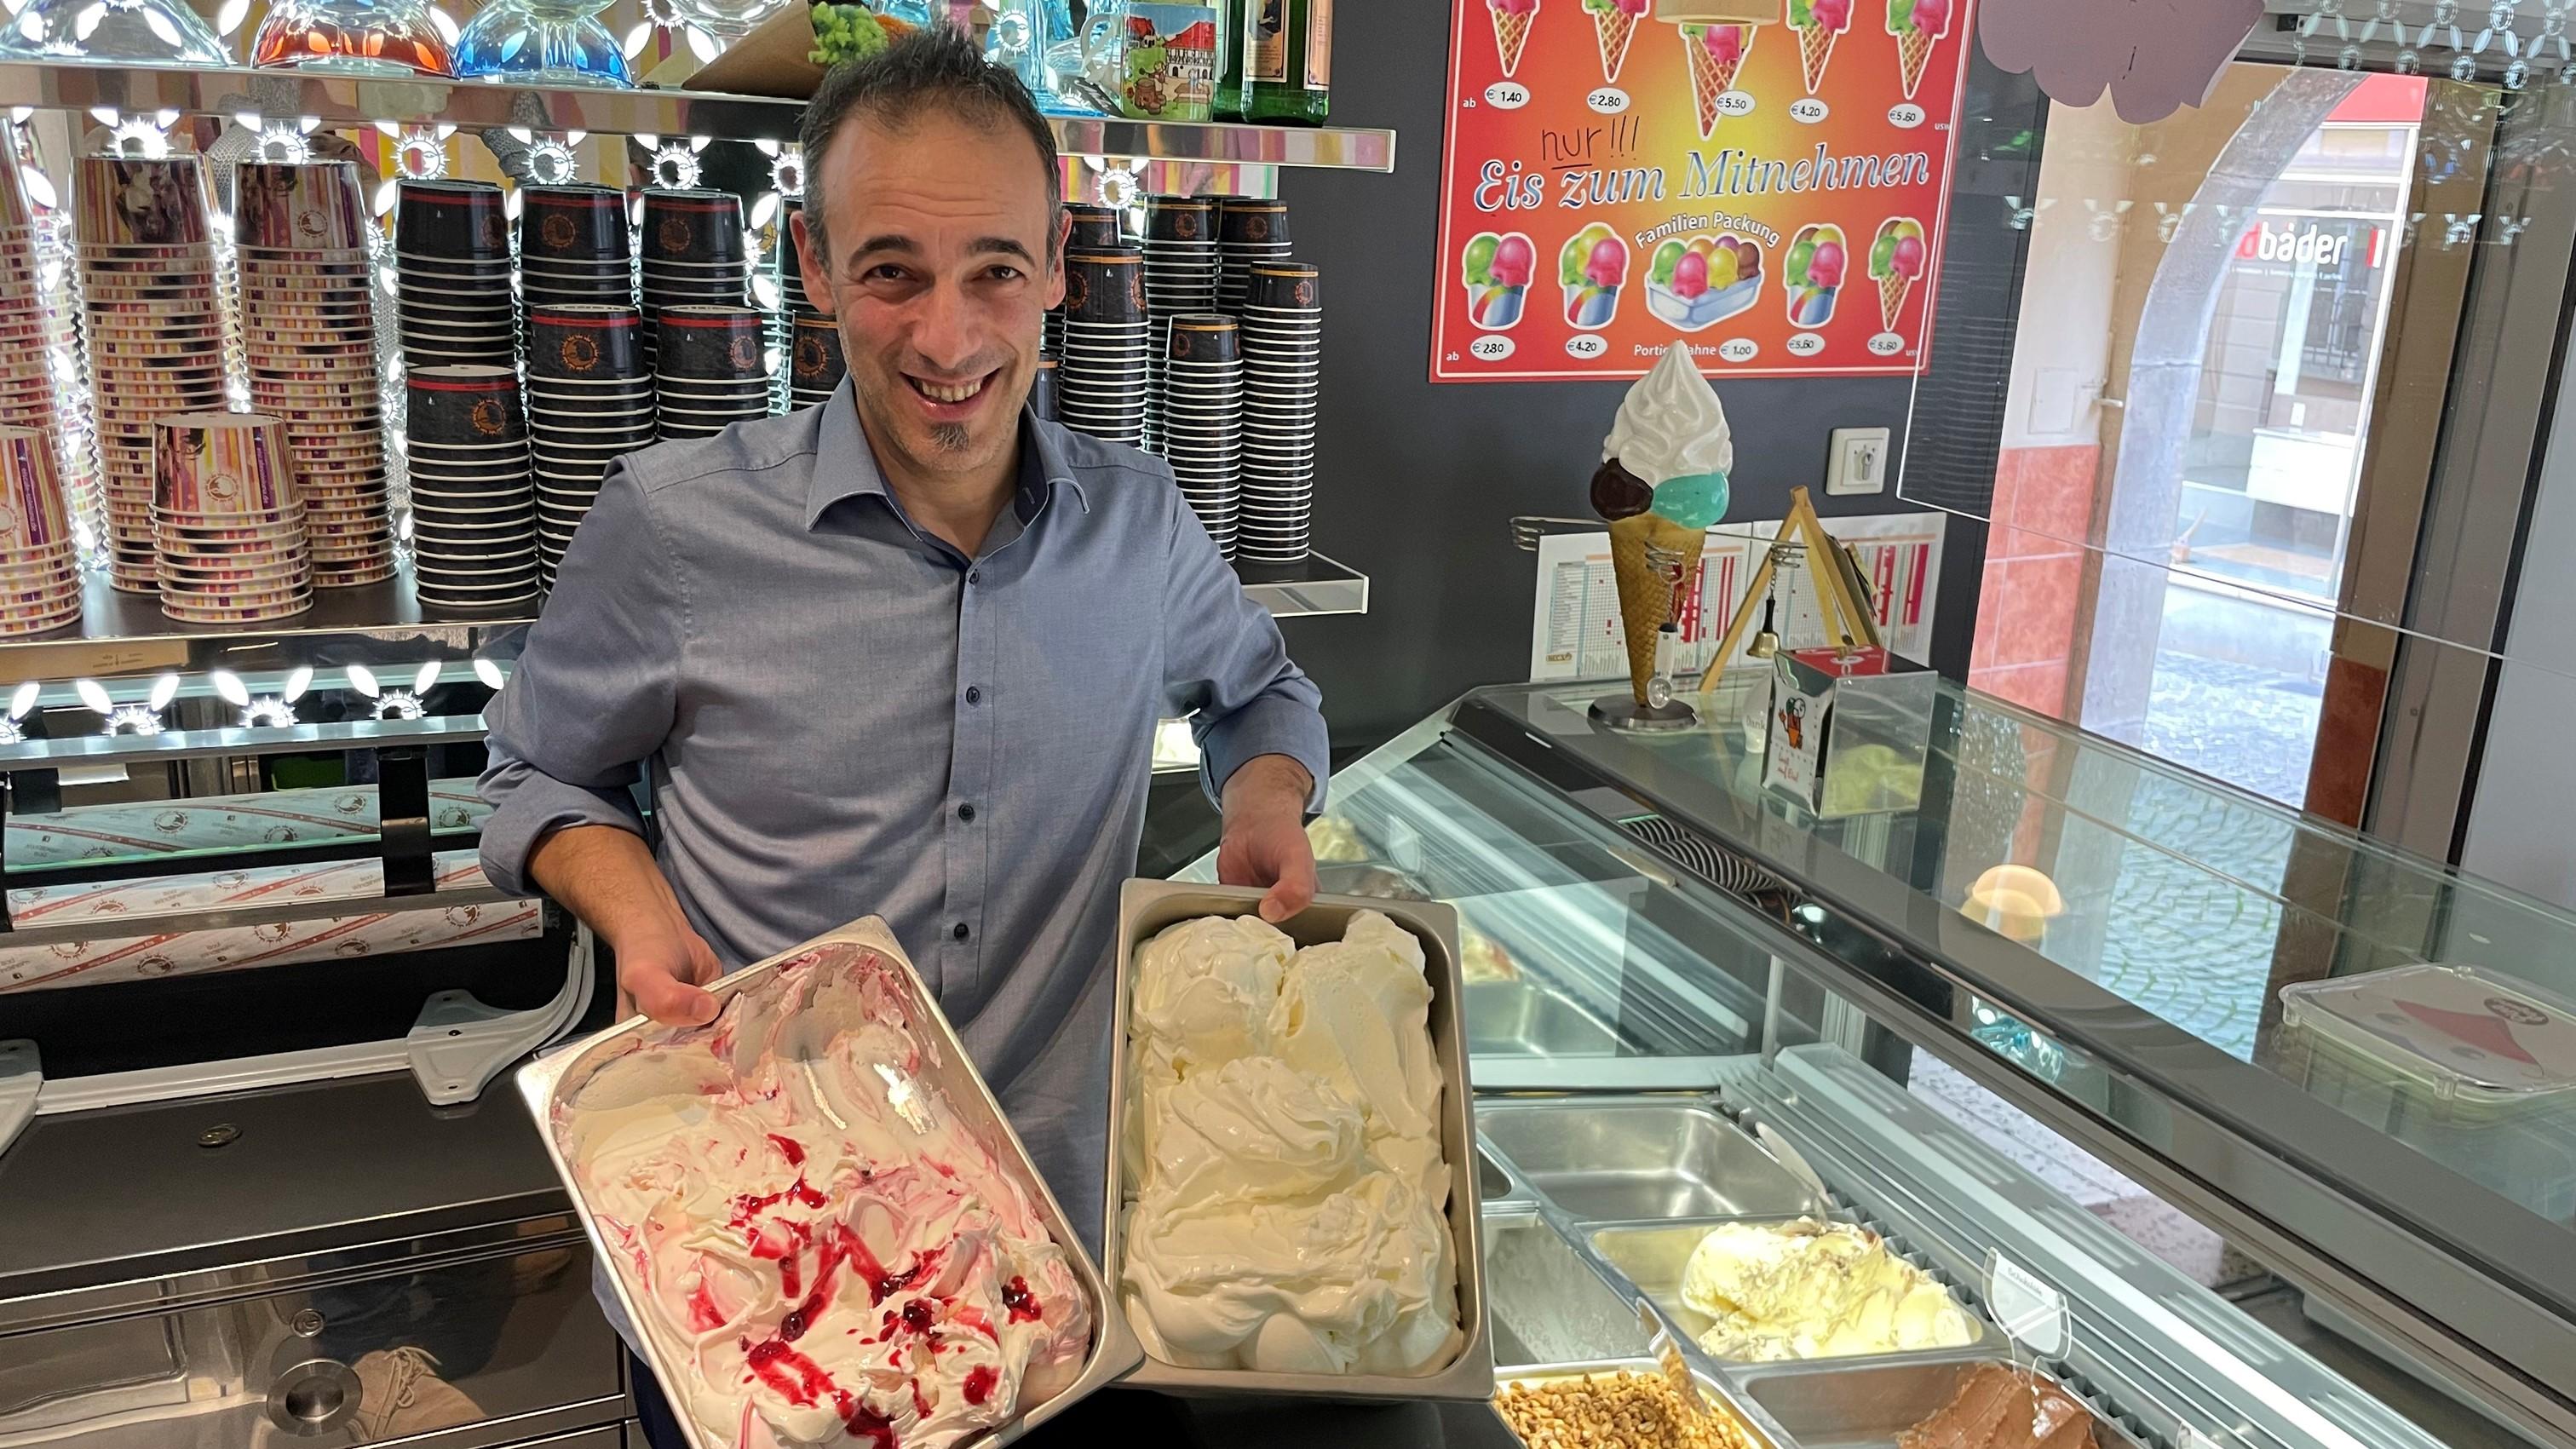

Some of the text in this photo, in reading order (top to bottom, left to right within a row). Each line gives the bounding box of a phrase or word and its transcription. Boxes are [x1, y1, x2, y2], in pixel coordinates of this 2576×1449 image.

[1463, 98, 1476, 108] ab
[1474, 141, 1930, 211] Eis zum Mitnehmen
[1634, 210, 1781, 250] Familien Packung
[1687, 344, 1716, 355] ahne
[1446, 351, 1459, 361] ab
